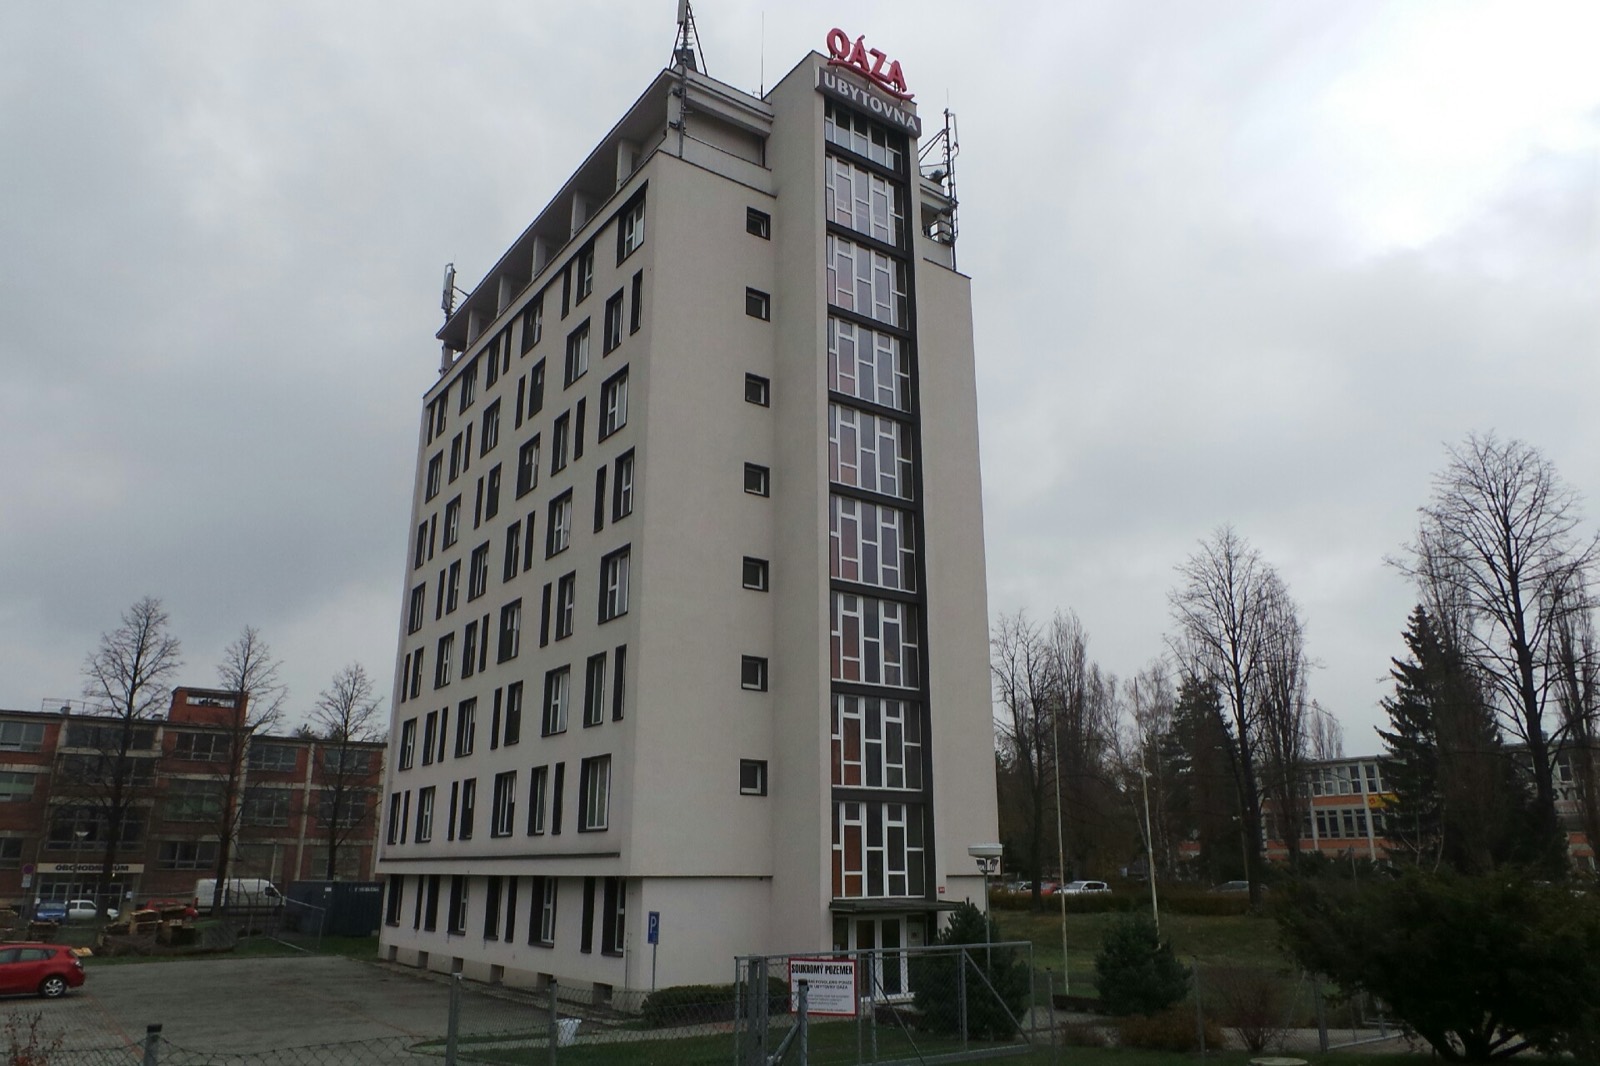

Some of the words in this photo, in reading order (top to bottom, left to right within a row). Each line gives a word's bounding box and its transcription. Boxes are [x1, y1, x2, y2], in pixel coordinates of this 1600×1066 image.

[824, 72, 918, 131] UBYTOVNA
[55, 864, 104, 872] OBCHODN
[792, 963, 823, 974] SOUKROMÝ
[825, 965, 853, 974] POZEMEK
